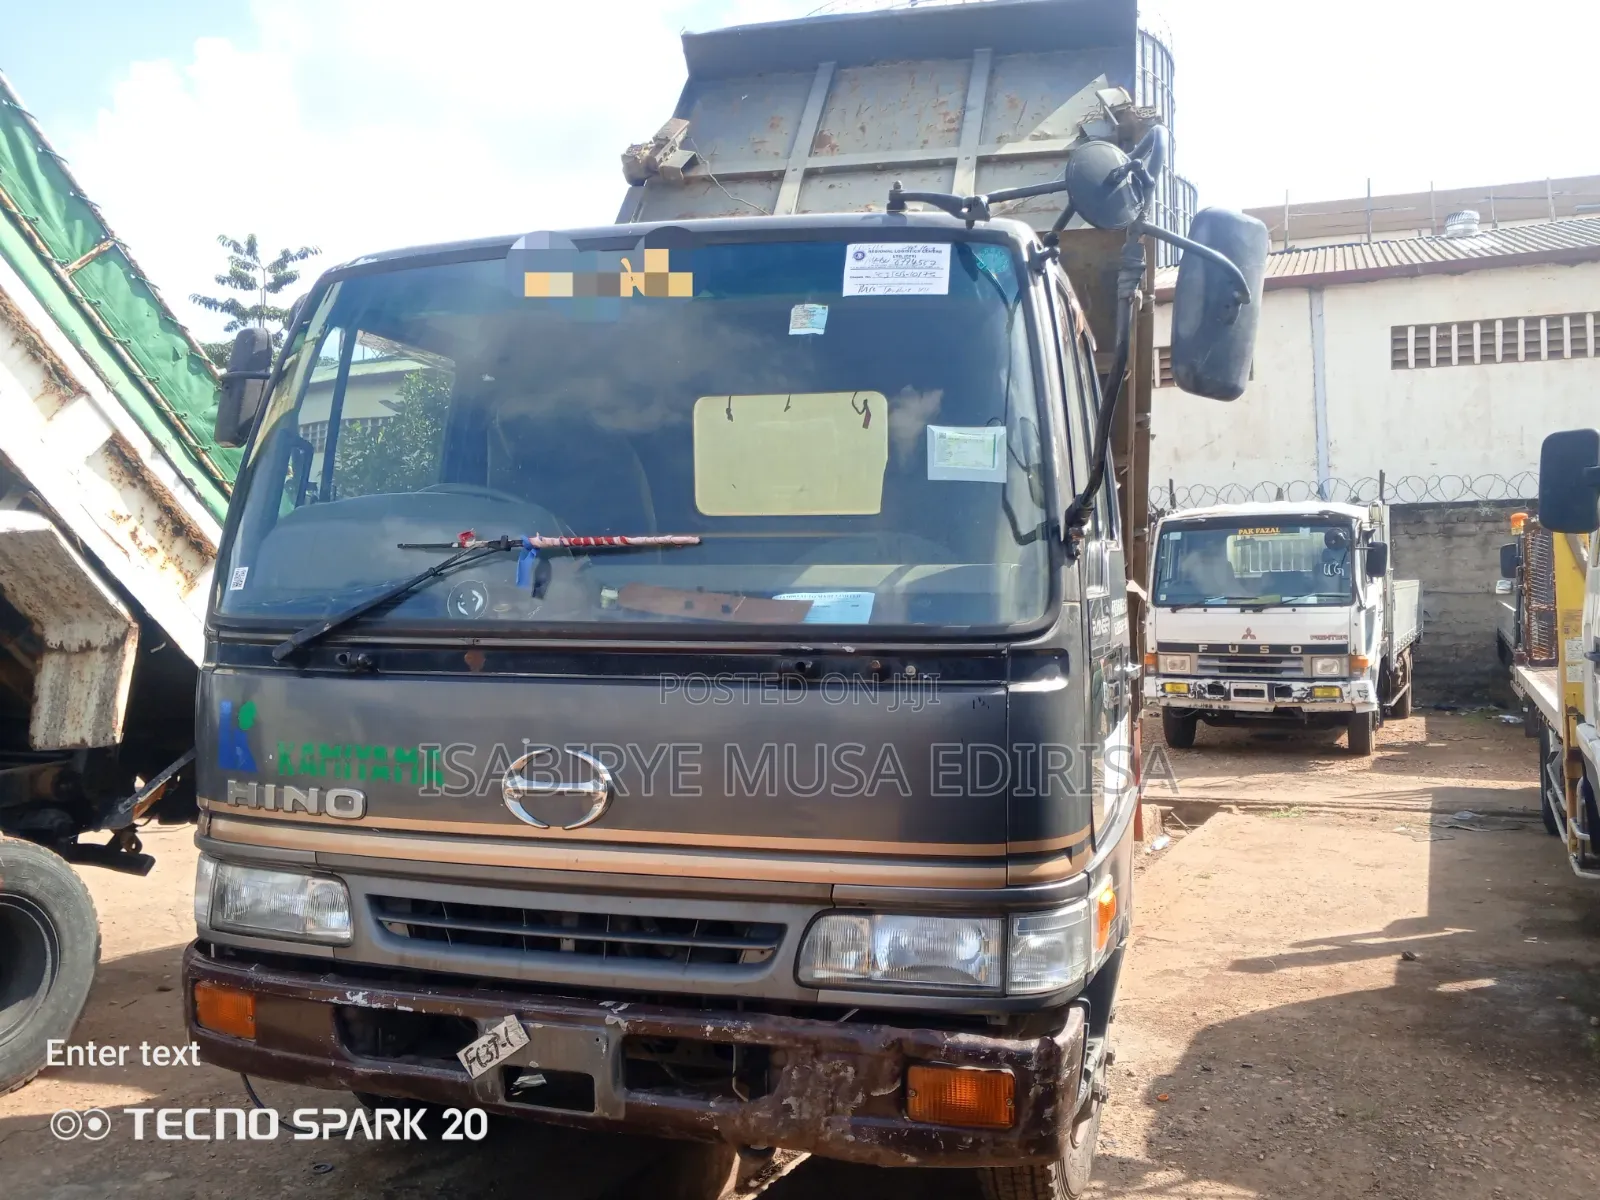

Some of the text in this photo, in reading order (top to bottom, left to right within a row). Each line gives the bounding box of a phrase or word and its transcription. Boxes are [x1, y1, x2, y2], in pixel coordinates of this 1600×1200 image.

[1238, 526, 1281, 536] PAK FAZAL
[1198, 644, 1303, 655] FUSO
[227, 779, 368, 820] HINO
